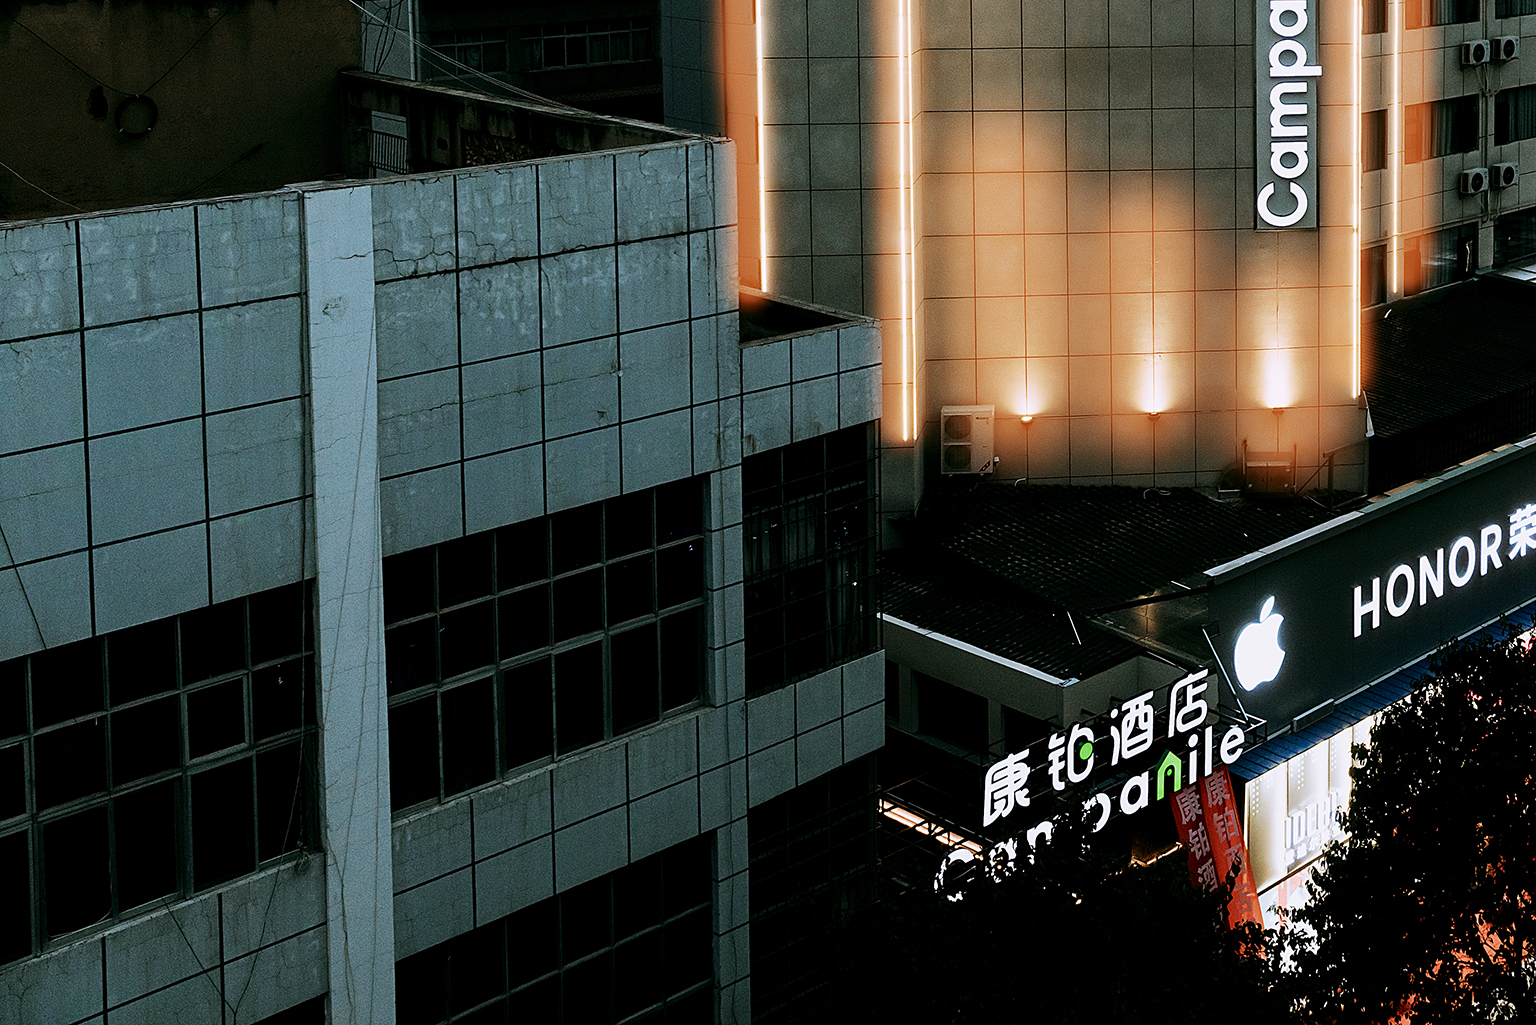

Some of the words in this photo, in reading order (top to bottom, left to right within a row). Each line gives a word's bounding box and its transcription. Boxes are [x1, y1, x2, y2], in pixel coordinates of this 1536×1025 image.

[983, 668, 1209, 827] 康铂酒店
[1175, 784, 1225, 932] 康铂酒
